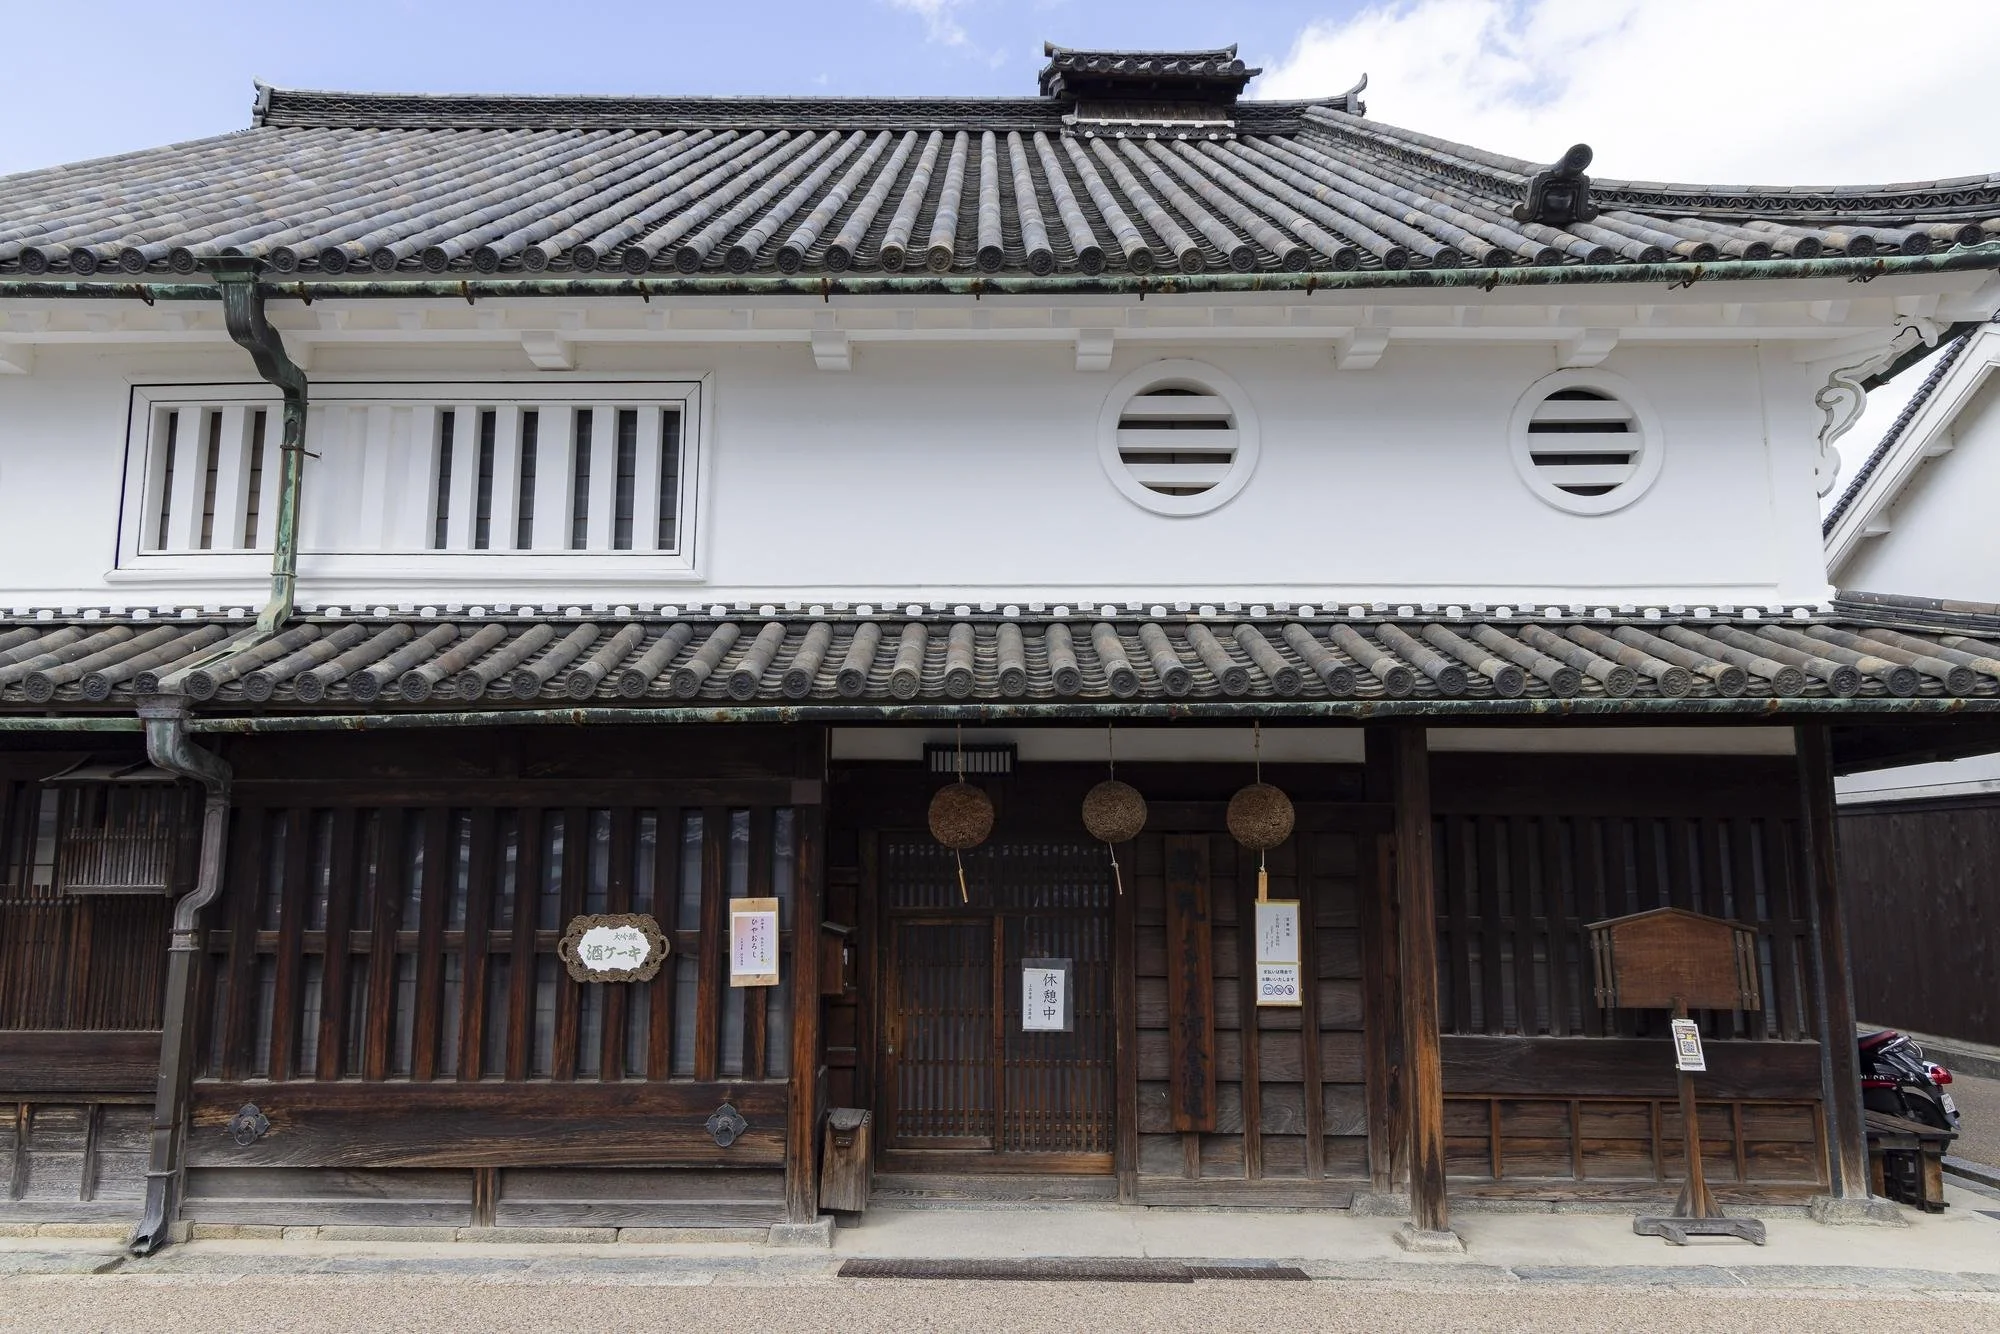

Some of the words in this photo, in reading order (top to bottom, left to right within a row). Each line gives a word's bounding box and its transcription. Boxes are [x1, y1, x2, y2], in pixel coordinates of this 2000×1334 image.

[586, 944, 641, 962] 酒ケーキ
[1043, 973, 1058, 1021] 休憩中
